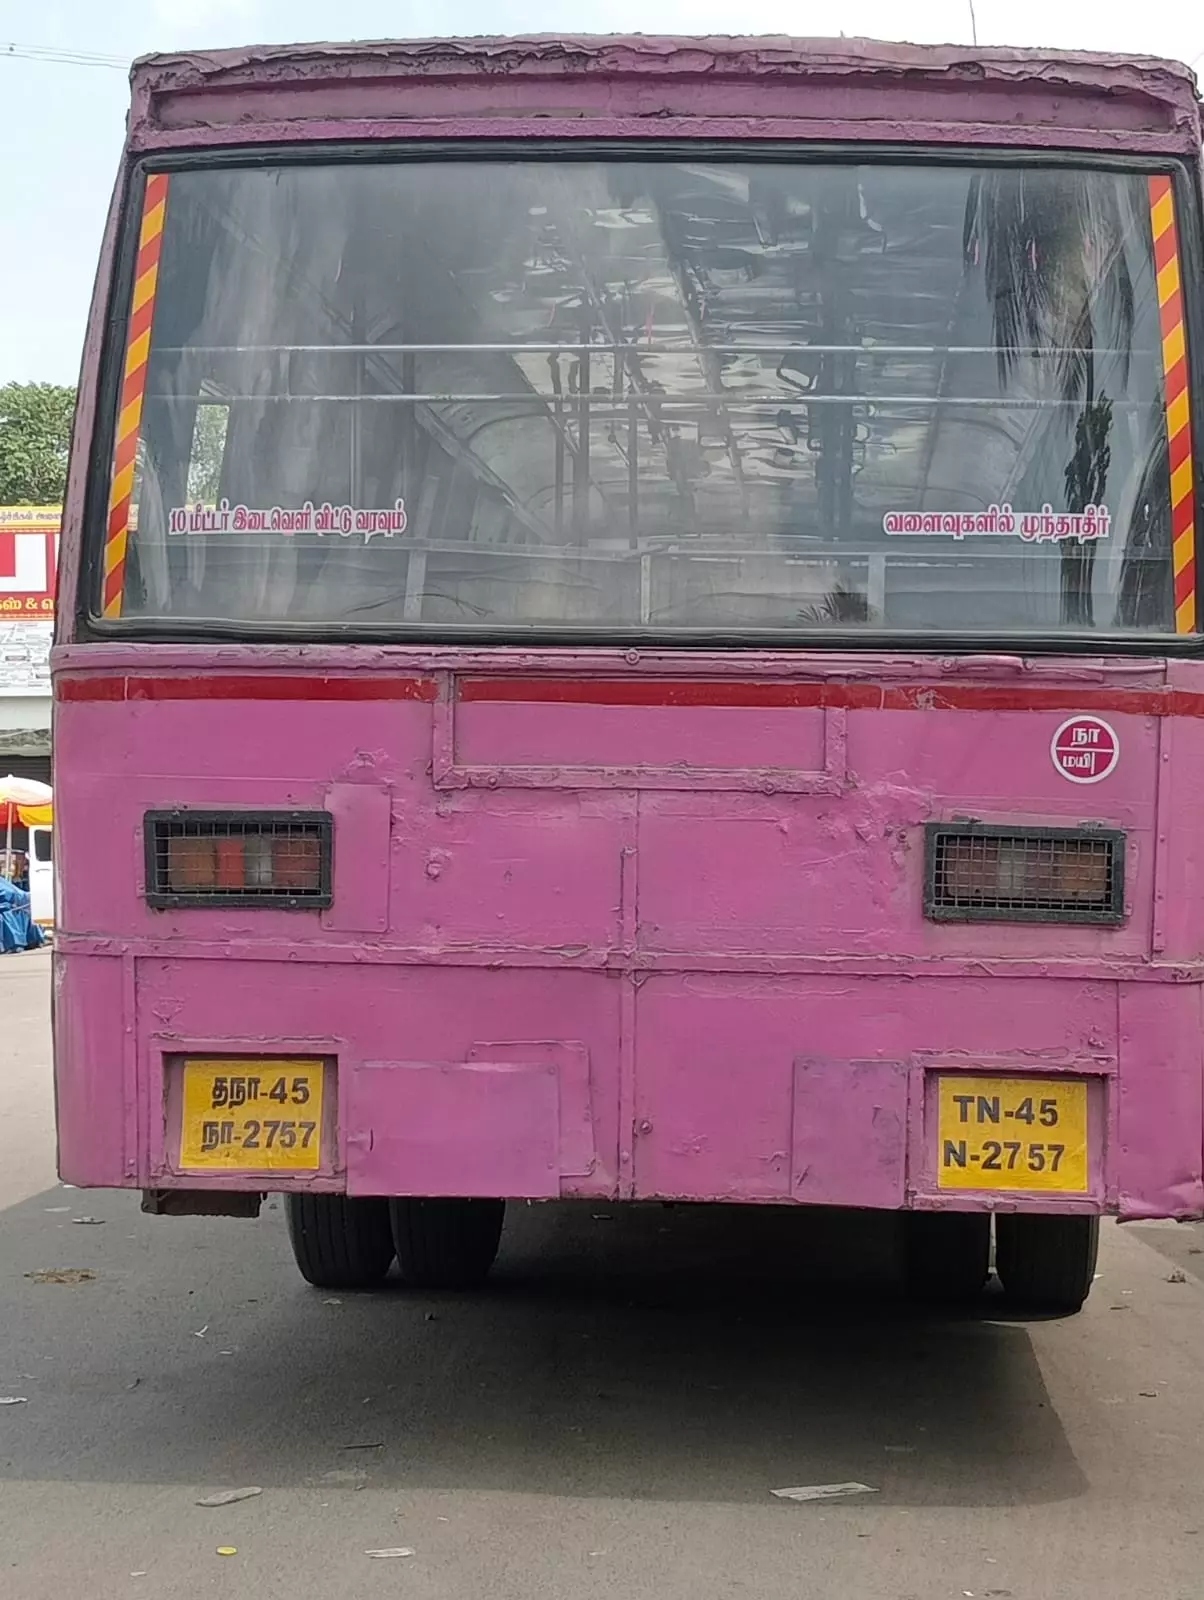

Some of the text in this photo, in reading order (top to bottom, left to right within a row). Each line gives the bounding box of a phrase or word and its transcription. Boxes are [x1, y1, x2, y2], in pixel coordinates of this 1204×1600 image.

[170, 500, 405, 537] 10 மீட்டர் இடைவெளி விட்டு வரவும்
[886, 505, 1109, 539] வளைவுகளில் முந்தாதீர்
[1070, 727, 1101, 747] நா
[212, 1077, 309, 1109] தநா-45
[953, 1095, 1059, 1127] TN-45
[200, 1119, 317, 1153] நா-2757
[943, 1139, 1065, 1172] N-2757
